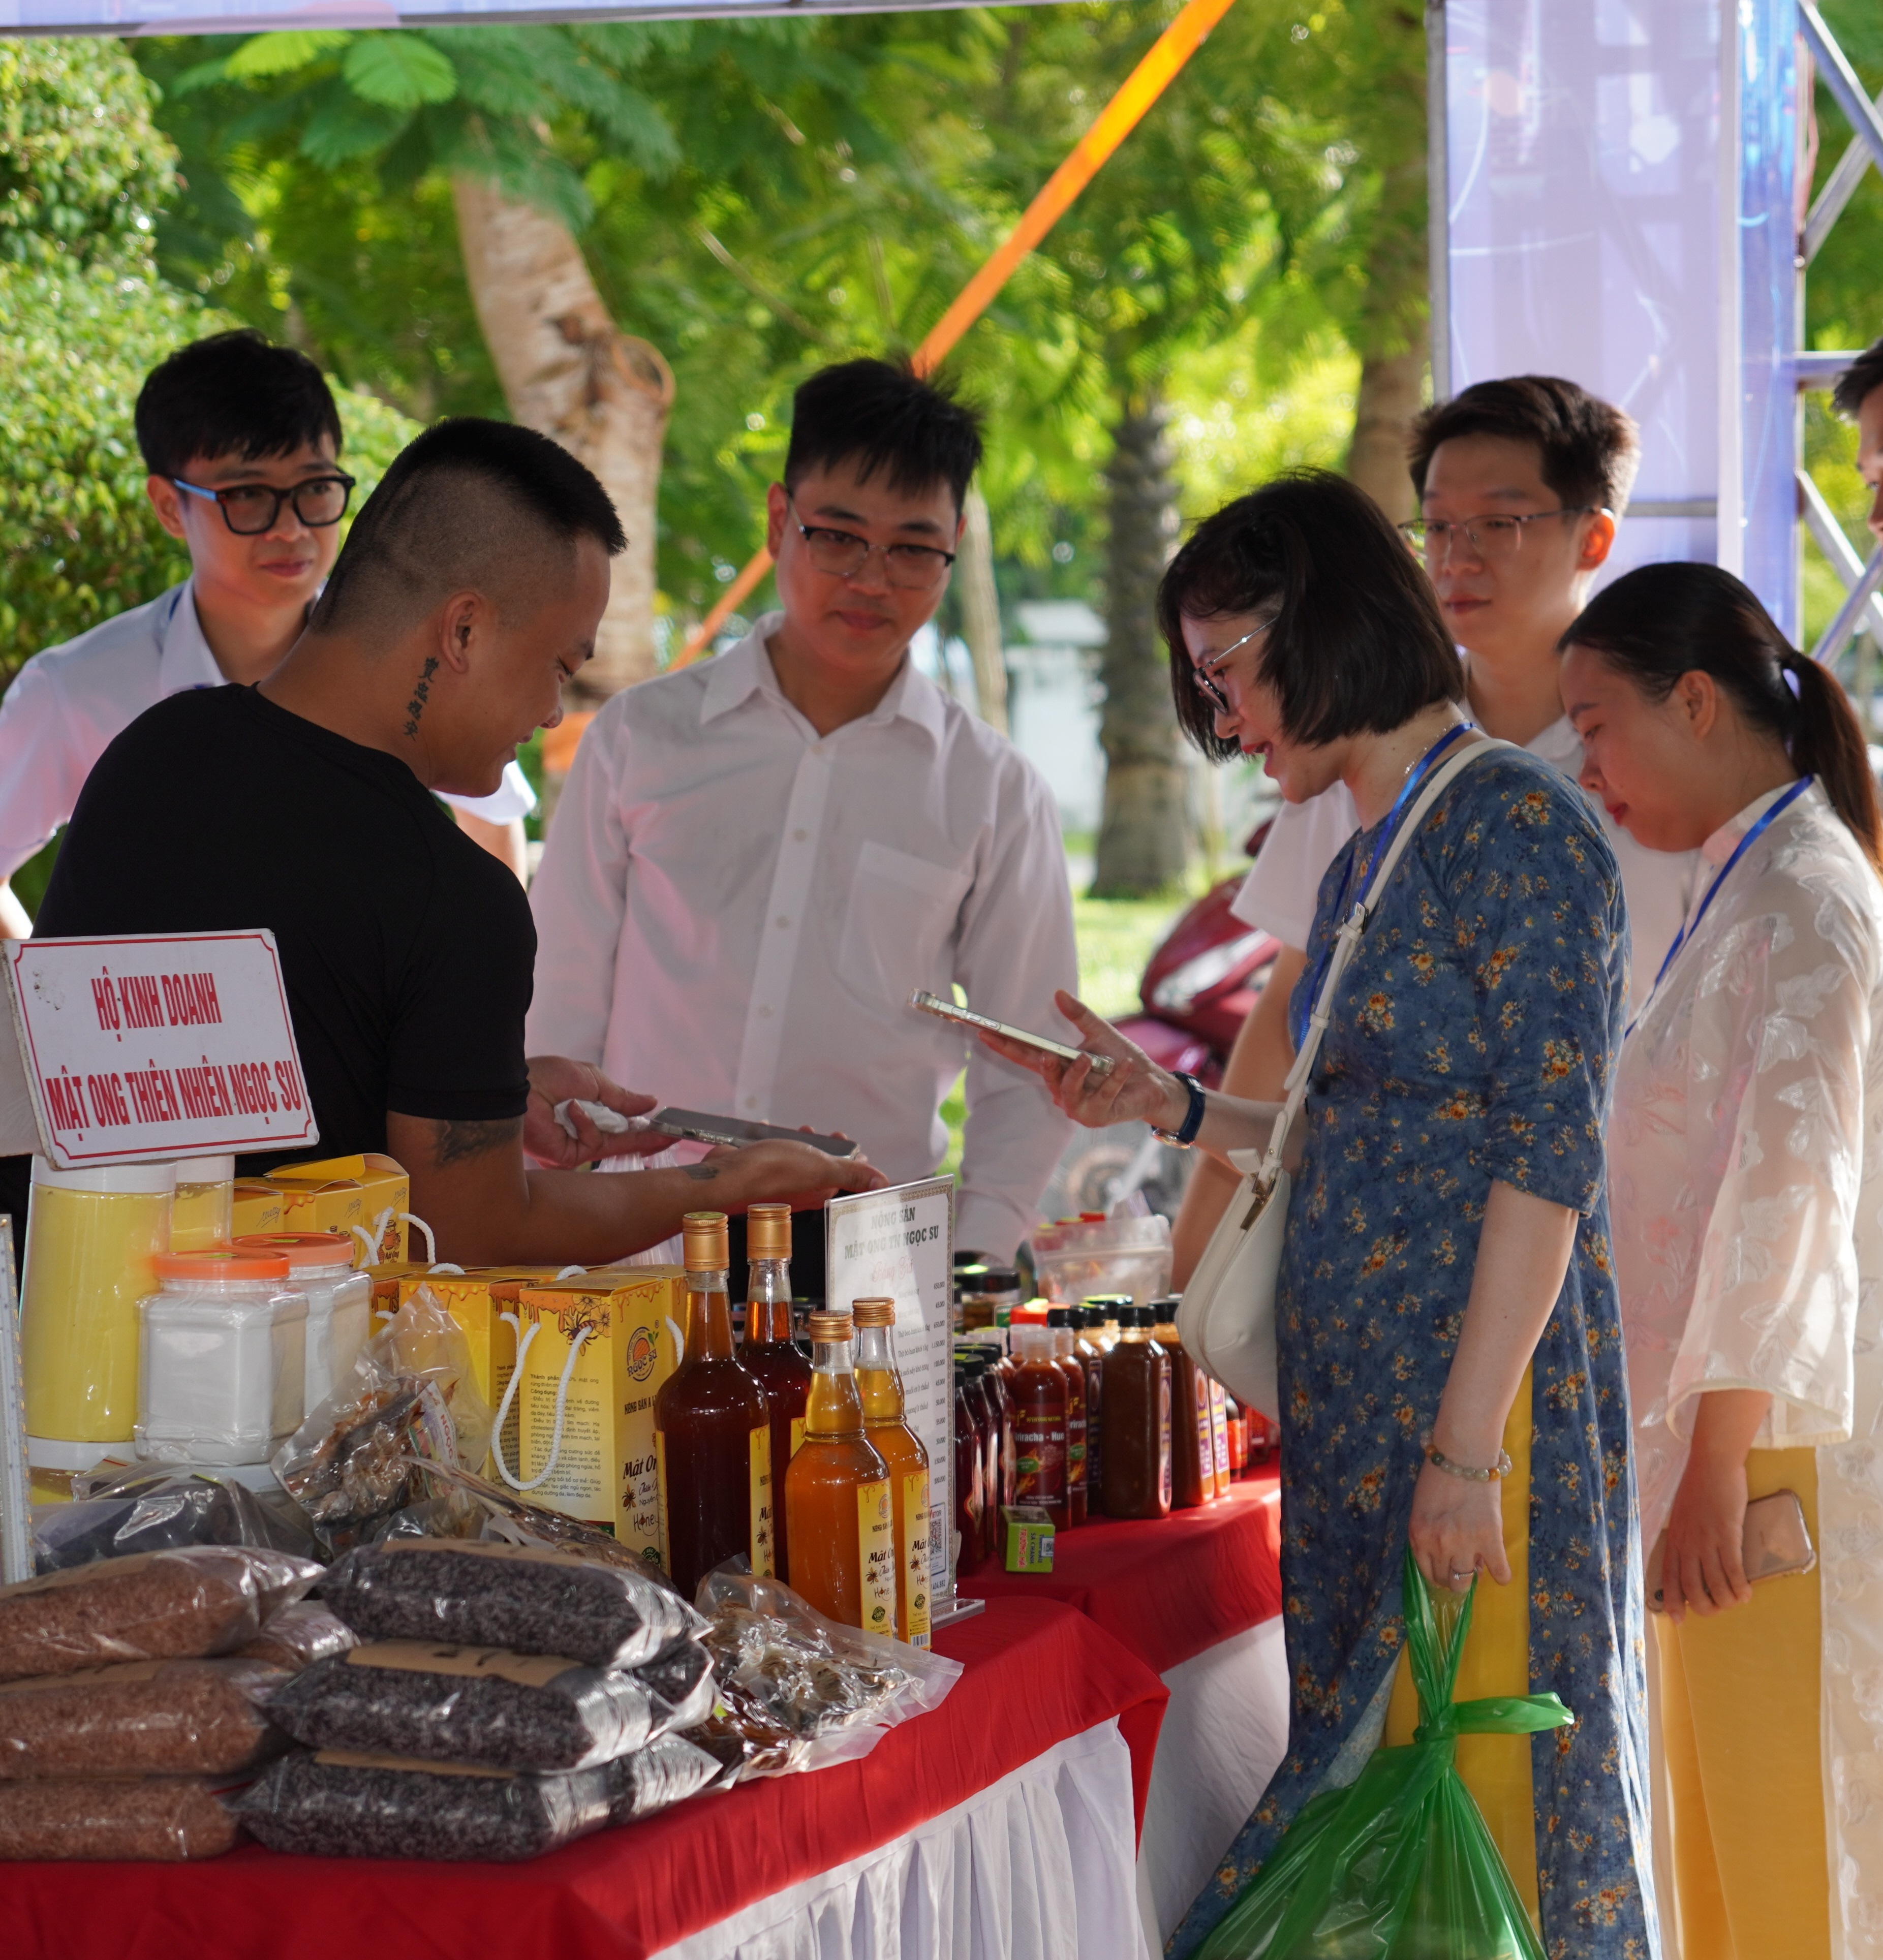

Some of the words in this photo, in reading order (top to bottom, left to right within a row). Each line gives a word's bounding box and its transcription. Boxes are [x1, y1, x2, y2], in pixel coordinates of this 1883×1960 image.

[91, 966, 121, 1042] HỘ
[117, 976, 165, 1029] KINH
[162, 973, 222, 1025] DOANH
[46, 1065, 90, 1141] MẬT
[88, 1073, 130, 1127] ONG
[125, 1059, 181, 1123] THIÊN
[176, 1055, 233, 1119] NHIÊN
[228, 1062, 277, 1124] NGỌC
[274, 1061, 301, 1111] SU
[899, 1203, 915, 1223] SẢN
[845, 1240, 865, 1261] MẬT
[867, 1237, 887, 1254] ONG
[889, 1233, 903, 1249] TN
[904, 1228, 927, 1247] NGỌC
[930, 1225, 939, 1239] SU
[623, 1458, 644, 1480] Mật
[912, 1539, 927, 1552] Mật
[869, 1550, 886, 1565] Mật
